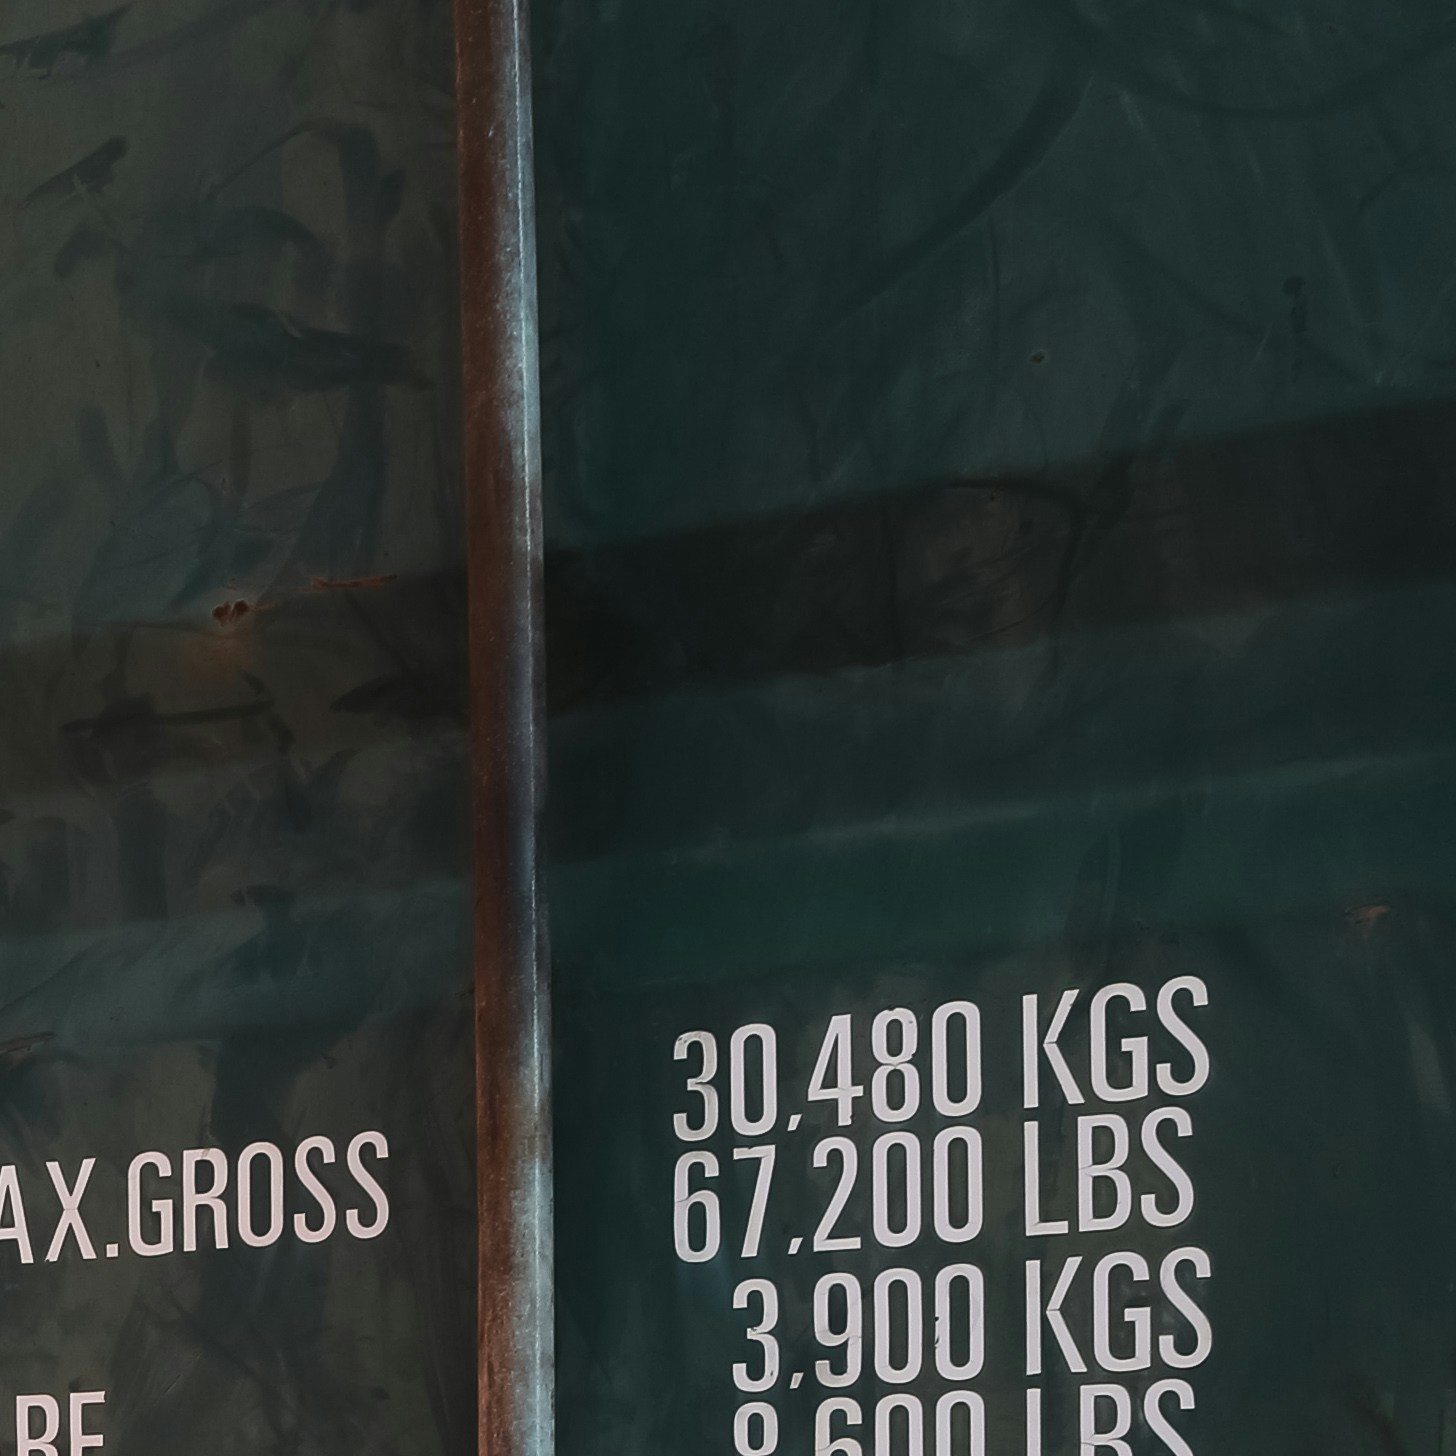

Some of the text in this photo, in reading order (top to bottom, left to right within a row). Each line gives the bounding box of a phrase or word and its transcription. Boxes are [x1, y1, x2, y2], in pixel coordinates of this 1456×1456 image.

[673, 976, 1209, 1142] 30,480 KGS
[673, 1107, 1193, 1262] 67,200 LBS
[733, 1247, 1212, 1392] 3,900 KGS
